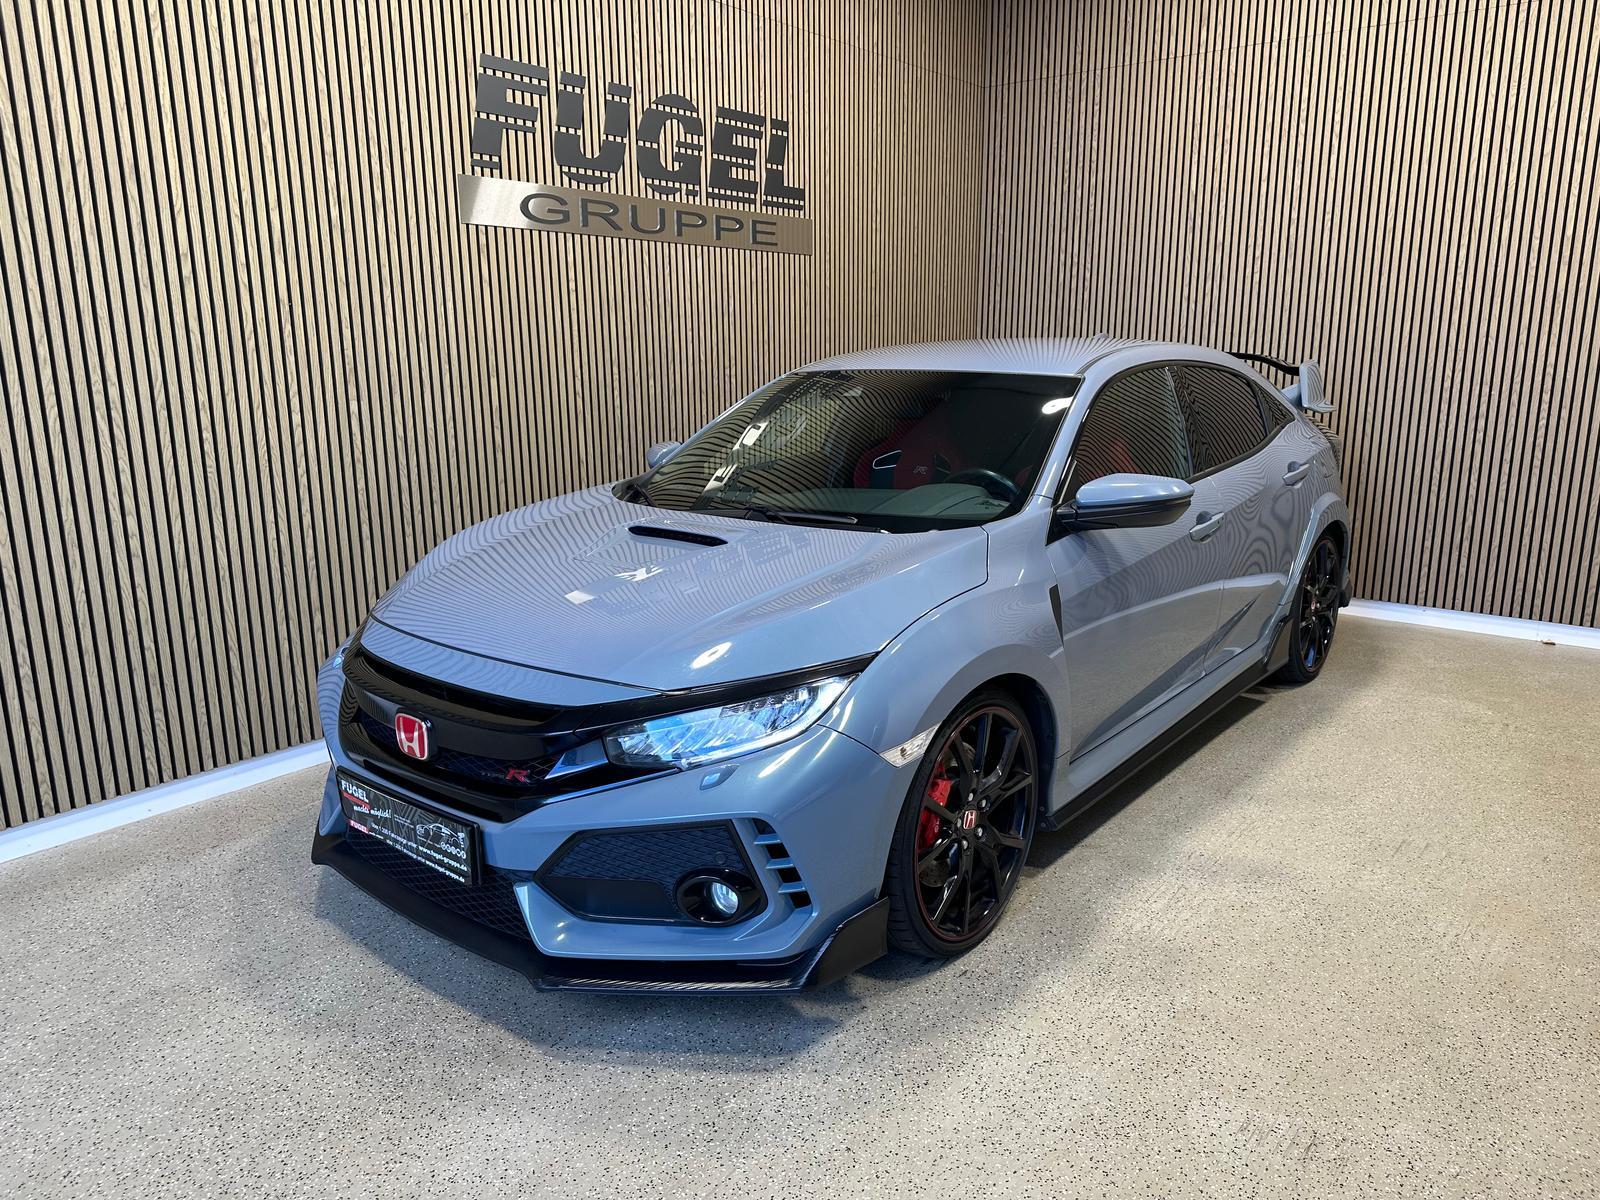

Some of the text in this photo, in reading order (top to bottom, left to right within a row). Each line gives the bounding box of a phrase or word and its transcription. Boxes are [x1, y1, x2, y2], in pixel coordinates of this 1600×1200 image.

[471, 53, 805, 210] FUGEL
[519, 192, 778, 246] GRUPPE
[341, 779, 369, 803] FUGEL
[350, 819, 369, 834] FUGEL
